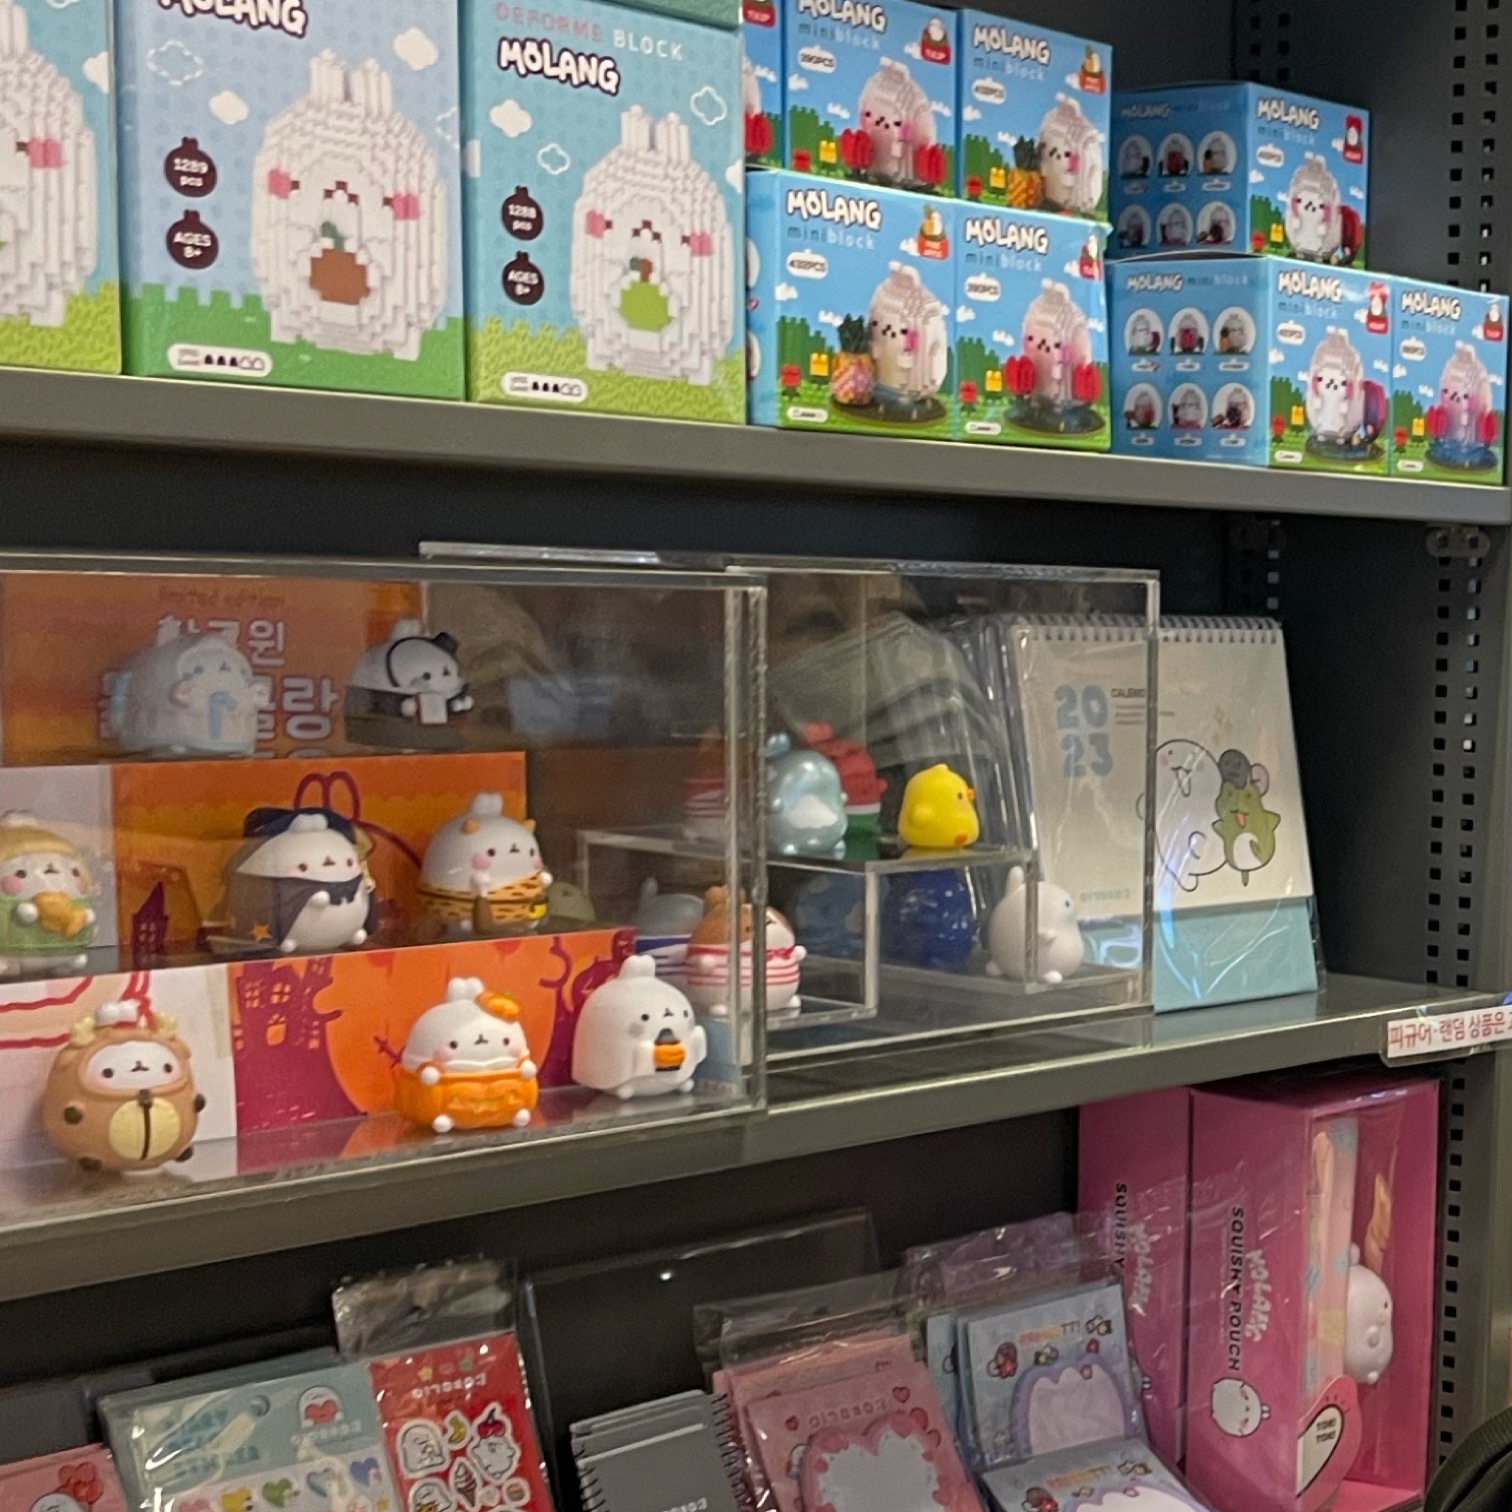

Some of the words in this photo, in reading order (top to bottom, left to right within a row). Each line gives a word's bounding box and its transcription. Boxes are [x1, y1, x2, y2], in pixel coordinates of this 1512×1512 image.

[612, 28, 683, 62] BLOCK
[973, 25, 1050, 65] MOLANG
[498, 38, 621, 96] MOLANG
[1256, 99, 1321, 131] MOLANG
[786, 190, 882, 231] MOLANG
[173, 231, 211, 247] AGES
[965, 218, 1049, 256] MOLANG
[1126, 272, 1184, 293] MOLANG
[1278, 270, 1343, 303] MOLANG
[1401, 291, 1463, 321] MOLANG
[1468, 1010, 1505, 1039] 상품은
[1245, 1249, 1272, 1343] MOLANG
[1227, 1300, 1242, 1372] POUCH
